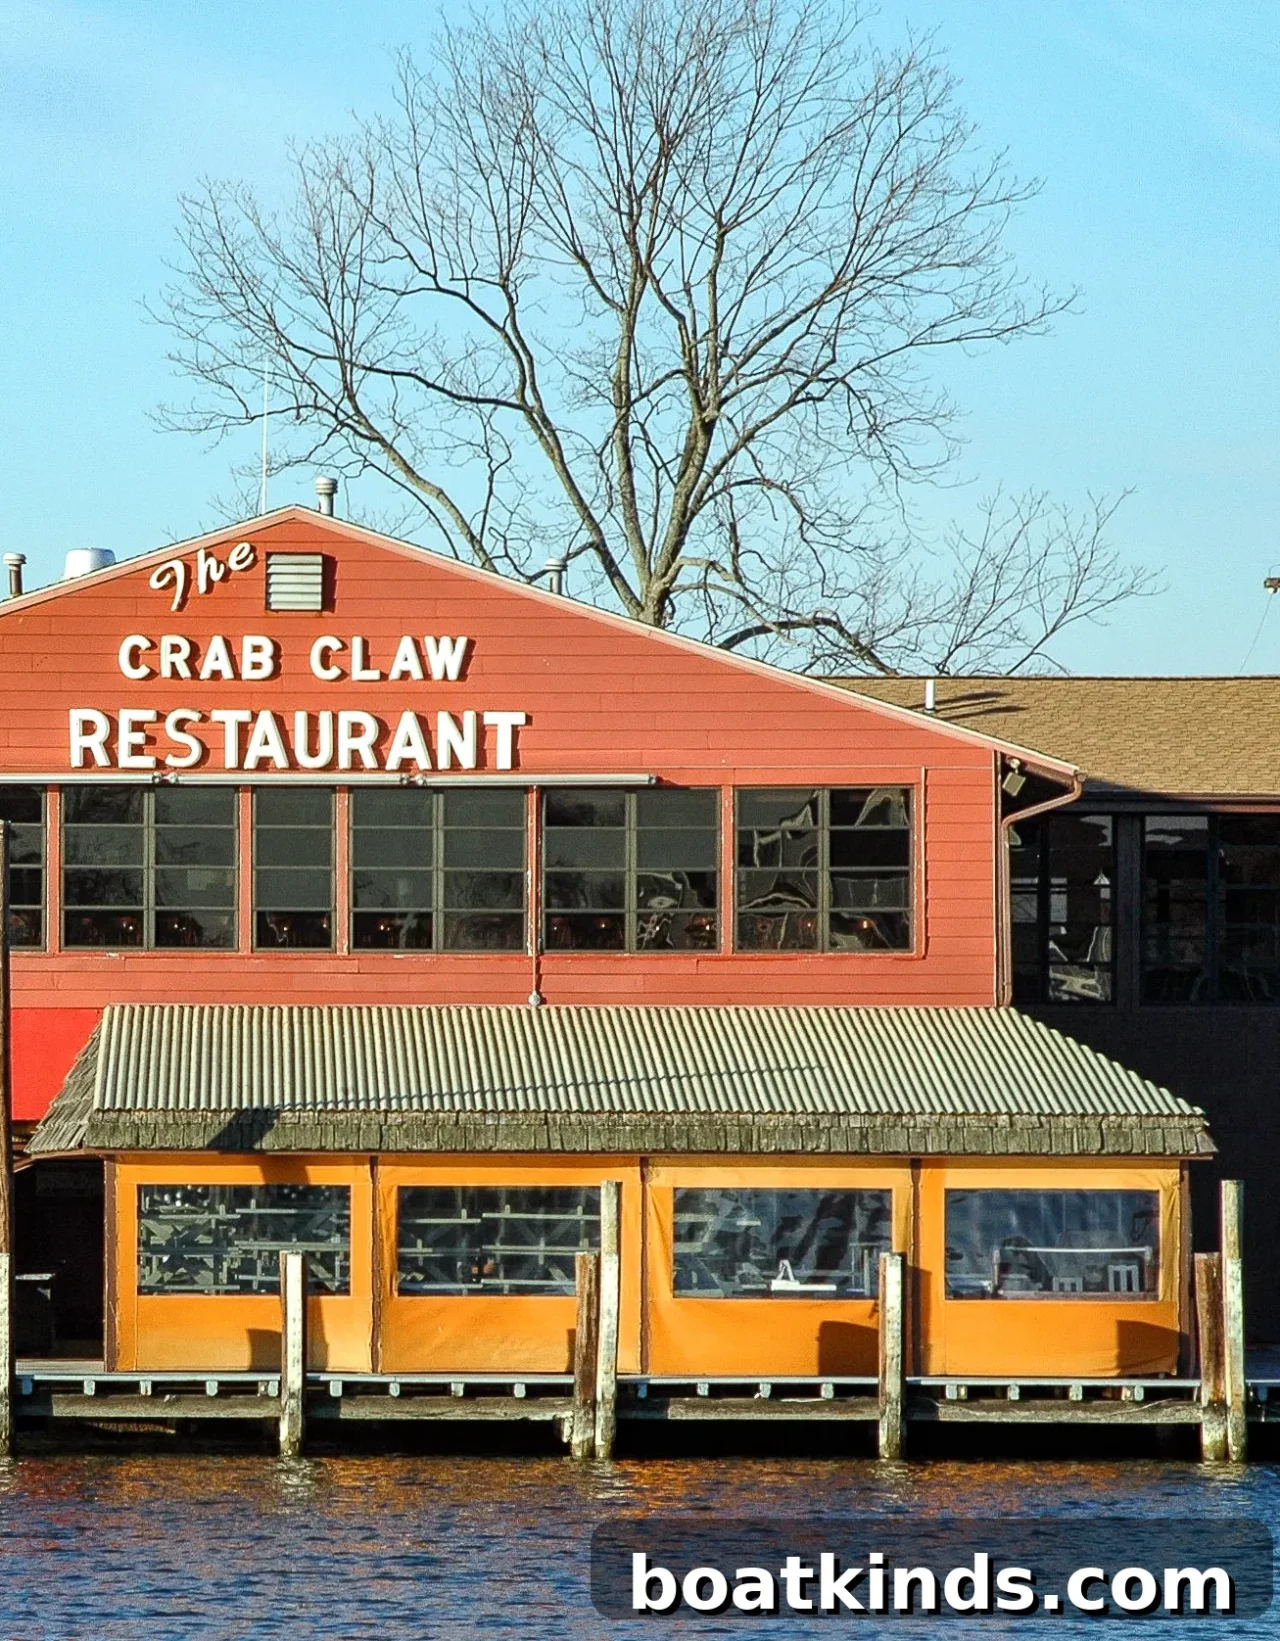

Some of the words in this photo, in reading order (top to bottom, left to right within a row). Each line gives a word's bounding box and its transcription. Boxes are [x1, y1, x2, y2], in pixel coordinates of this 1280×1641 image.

[149, 541, 256, 611] The
[119, 634, 274, 680] CRAB
[310, 634, 468, 680] CLAW
[69, 708, 527, 769] RESTAURANT
